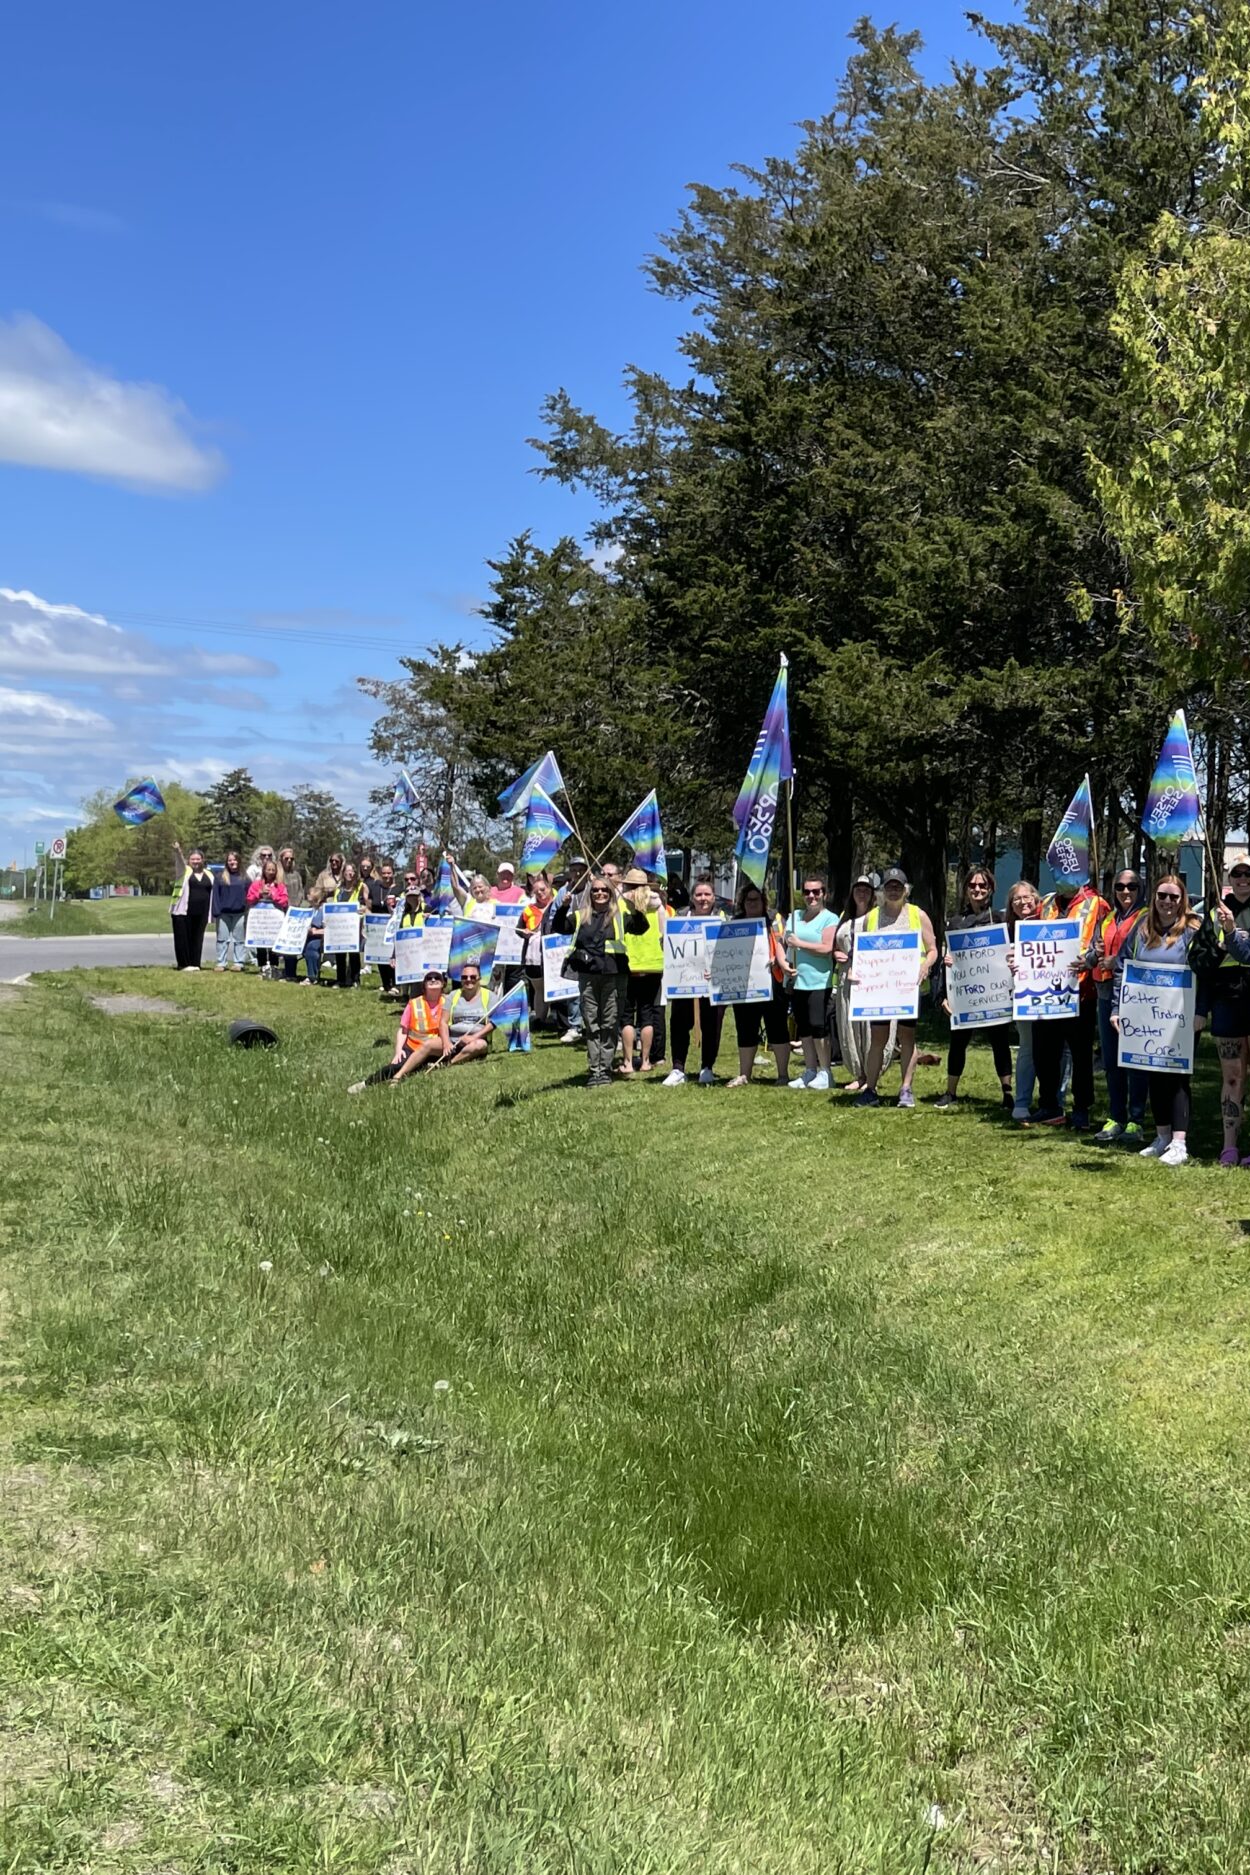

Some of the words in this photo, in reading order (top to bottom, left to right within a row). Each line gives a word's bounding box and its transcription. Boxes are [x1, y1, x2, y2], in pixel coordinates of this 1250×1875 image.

[1055, 840, 1070, 875] SEFPO
[1063, 837, 1081, 872] OPSEU
[1021, 940, 1064, 958] BILL
[969, 963, 990, 977] CAN
[1030, 954, 1056, 969] 124
[1122, 984, 1159, 1005] Better
[1121, 1017, 1166, 1037] Better
